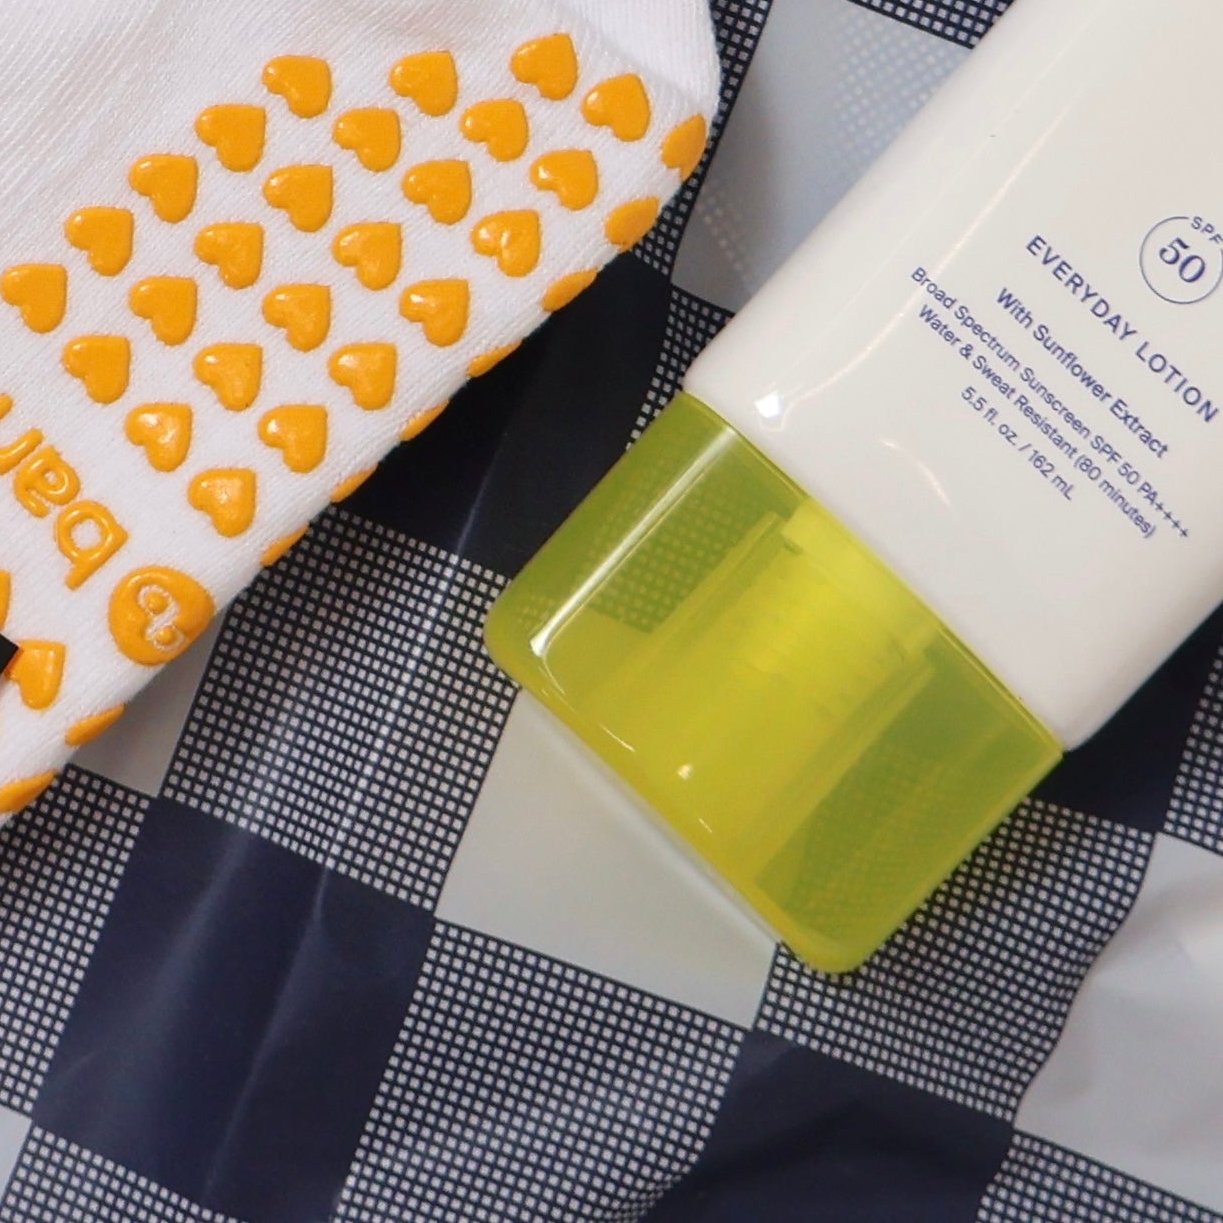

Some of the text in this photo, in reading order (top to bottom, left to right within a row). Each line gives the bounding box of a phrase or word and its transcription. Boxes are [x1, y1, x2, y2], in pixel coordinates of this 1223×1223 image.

[1159, 237, 1206, 283] 50
[1191, 216, 1223, 244] SPF
[911, 267, 1188, 537] Broad Spectrum Sunscreen SPF 50 PA++++
[996, 287, 1168, 458] With Sunflower Extract
[1025, 235, 1219, 423] EVERYDAY LOTION
[919, 304, 1156, 539] Water & Sweat Resistant (80 minutes)
[961, 386, 987, 411] 5.5
[998, 423, 1018, 446] oz.
[1028, 449, 1055, 478] 162
[1051, 475, 1075, 501] mL
